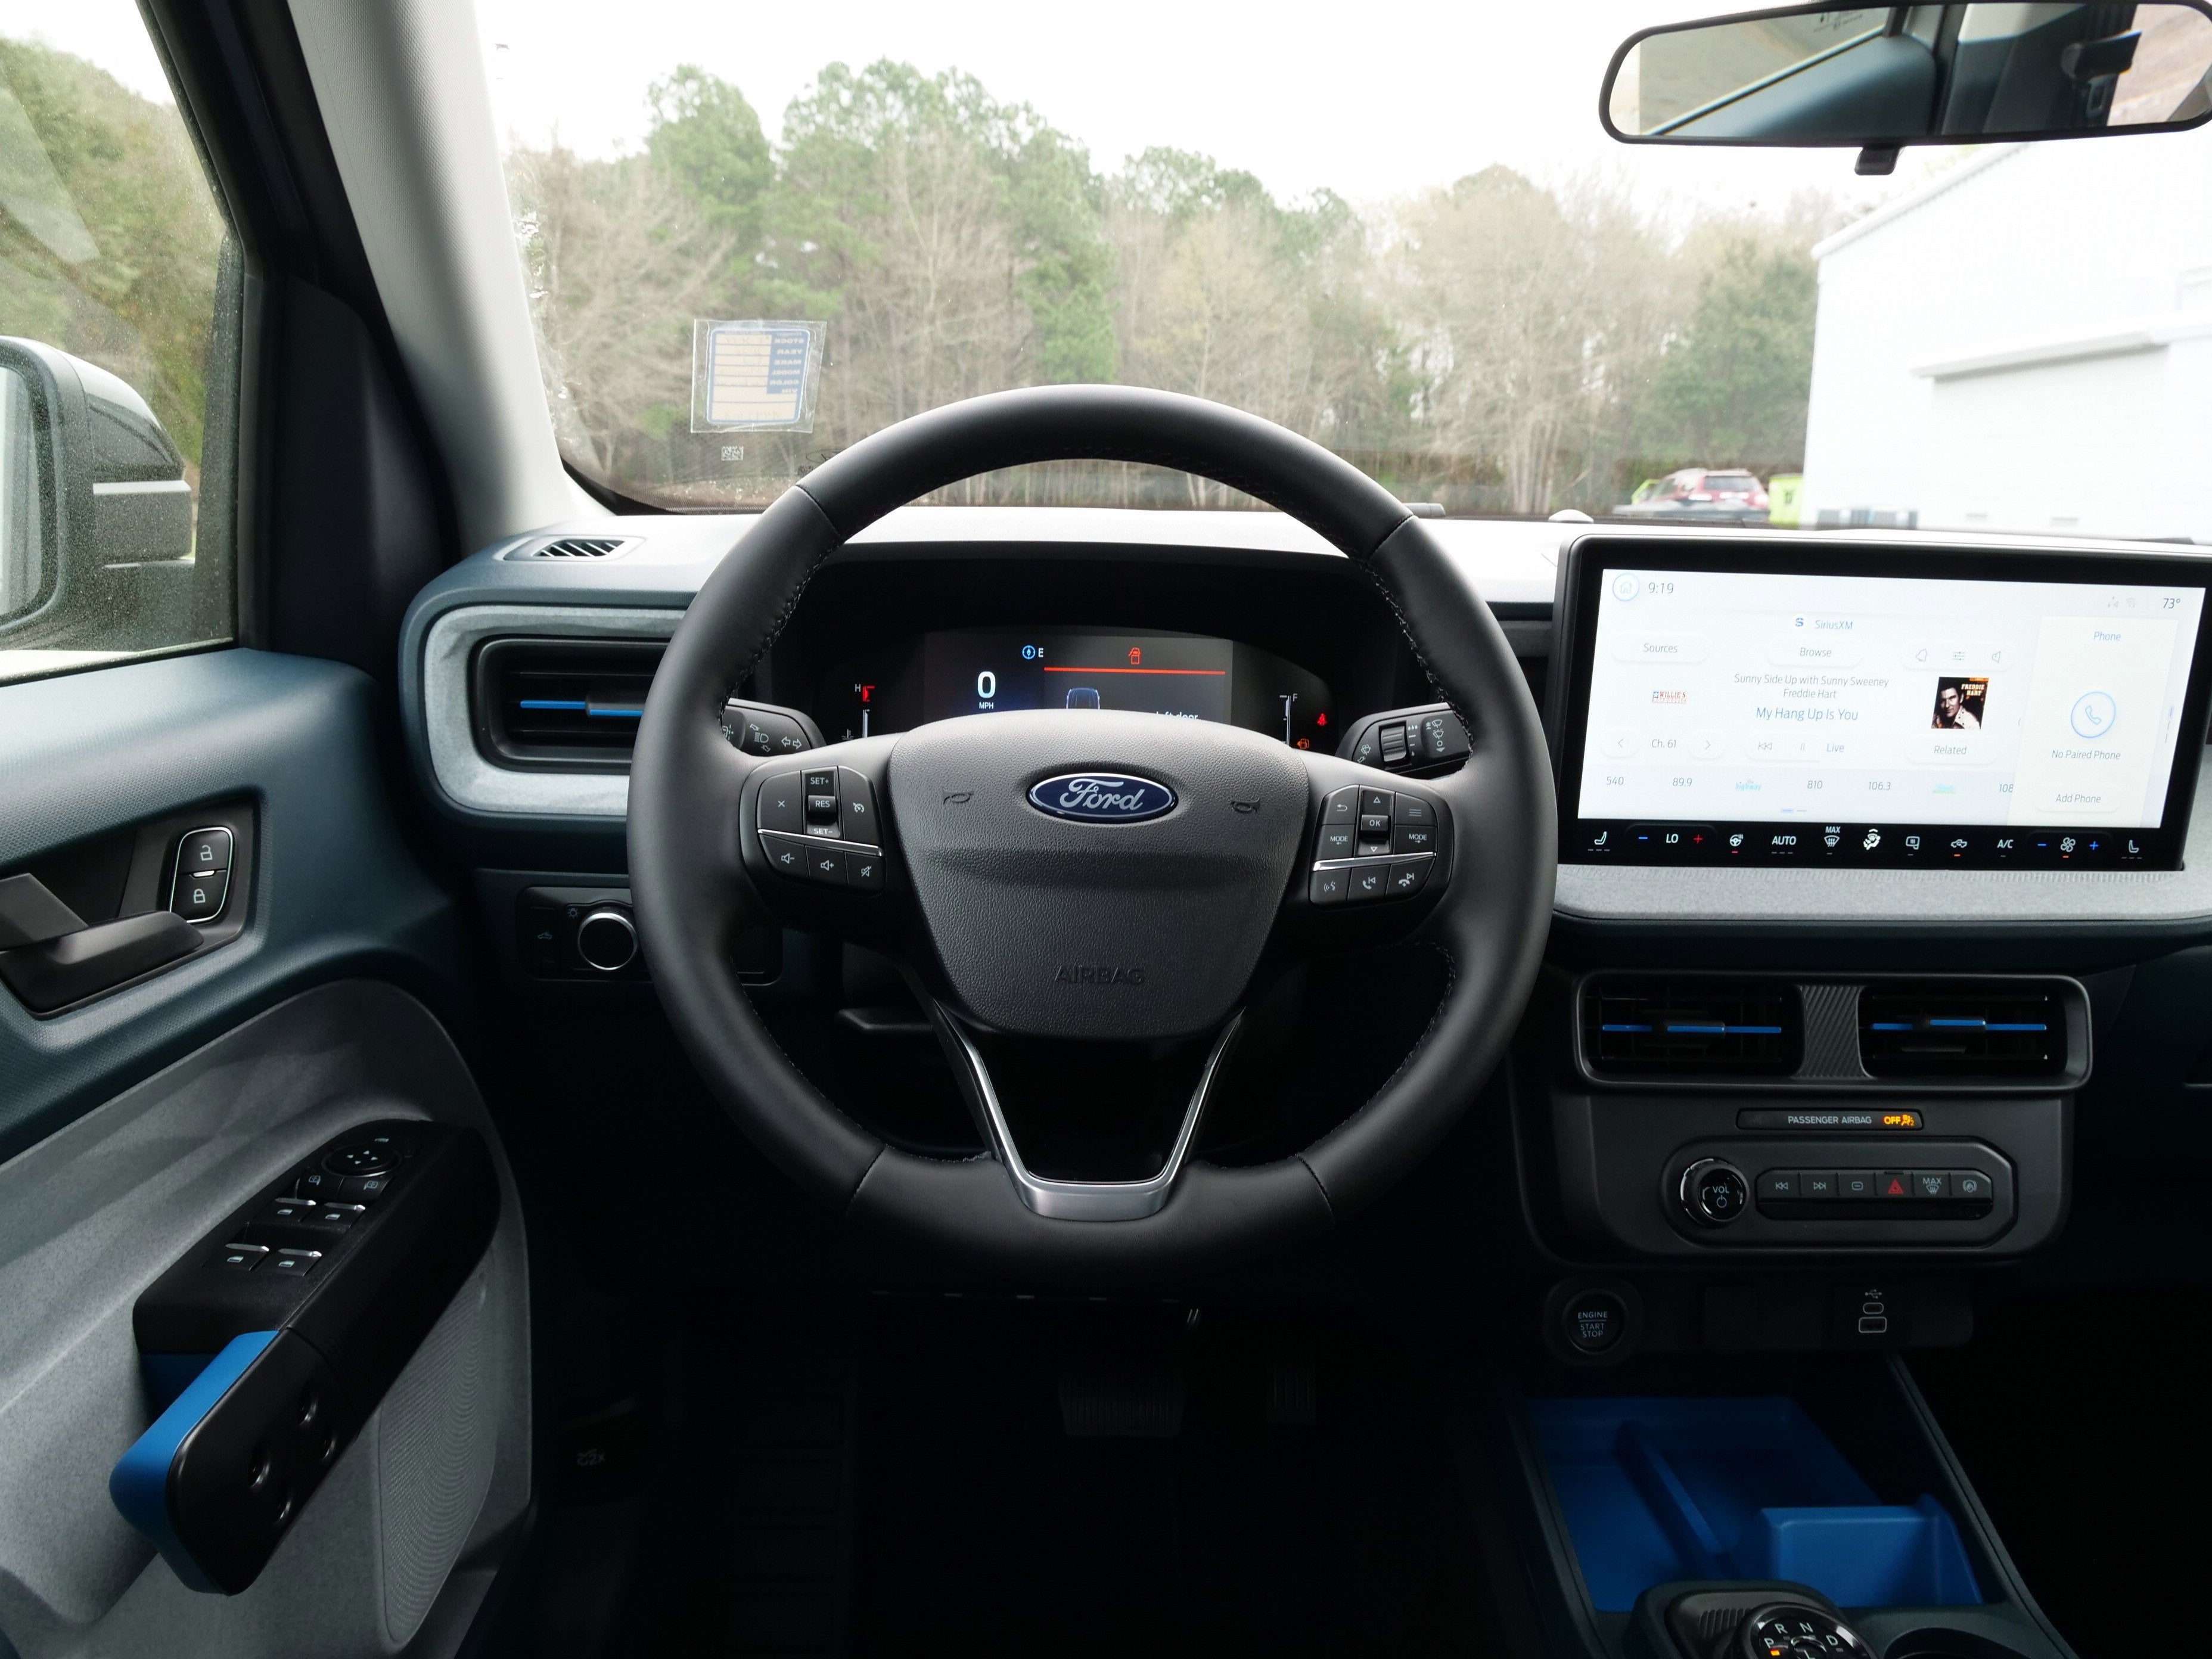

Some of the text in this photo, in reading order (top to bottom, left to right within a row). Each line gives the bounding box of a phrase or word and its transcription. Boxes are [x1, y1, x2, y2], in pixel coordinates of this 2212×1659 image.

[1648, 582, 1674, 594] 9:19
[2163, 598, 2180, 609] 73°
[1815, 620, 1853, 630] SiriusXM
[2093, 632, 2121, 641] Phone
[1038, 648, 1044, 658] E
[1644, 643, 1678, 653] Sources
[1800, 647, 1832, 657] Browse
[977, 671, 996, 699] 0
[1734, 674, 1889, 688] Sunny Side Up with Sunny Sweeney
[855, 684, 861, 692] H
[1783, 688, 1837, 698] Freddie Hart
[1293, 693, 1298, 702] F
[979, 701, 994, 710] MPH
[1756, 707, 1859, 721] My Hang Up Is You
[1651, 739, 1677, 748] Ch. 61
[1826, 743, 1845, 753] Live
[1934, 745, 1967, 755] Related
[2052, 750, 2121, 760] No Paired Phone
[1606, 776, 1624, 785] 540
[1672, 778, 1692, 787] 89.9
[1807, 780, 1823, 789] 810
[1868, 781, 1891, 791] 106.3
[1060, 778, 1145, 811] Ford
[2056, 794, 2101, 803] Add Phone
[1666, 833, 1679, 844] LO
[1772, 835, 1797, 846] AUTO
[1997, 839, 2014, 849] A/C
[1054, 965, 1145, 984] AIRBAG
[1788, 1116, 1872, 1124] PASSENGER AIRBAG
[1884, 1116, 1901, 1125] OFF
[1922, 1177, 1942, 1185] MAX
[1712, 1185, 1730, 1194] VOL
[1577, 1310, 1608, 1319] ENGINE
[1774, 1623, 1788, 1635] R
[1799, 1622, 1814, 1633] N
[1764, 1638, 1775, 1649] P
[1825, 1634, 1839, 1646] D
